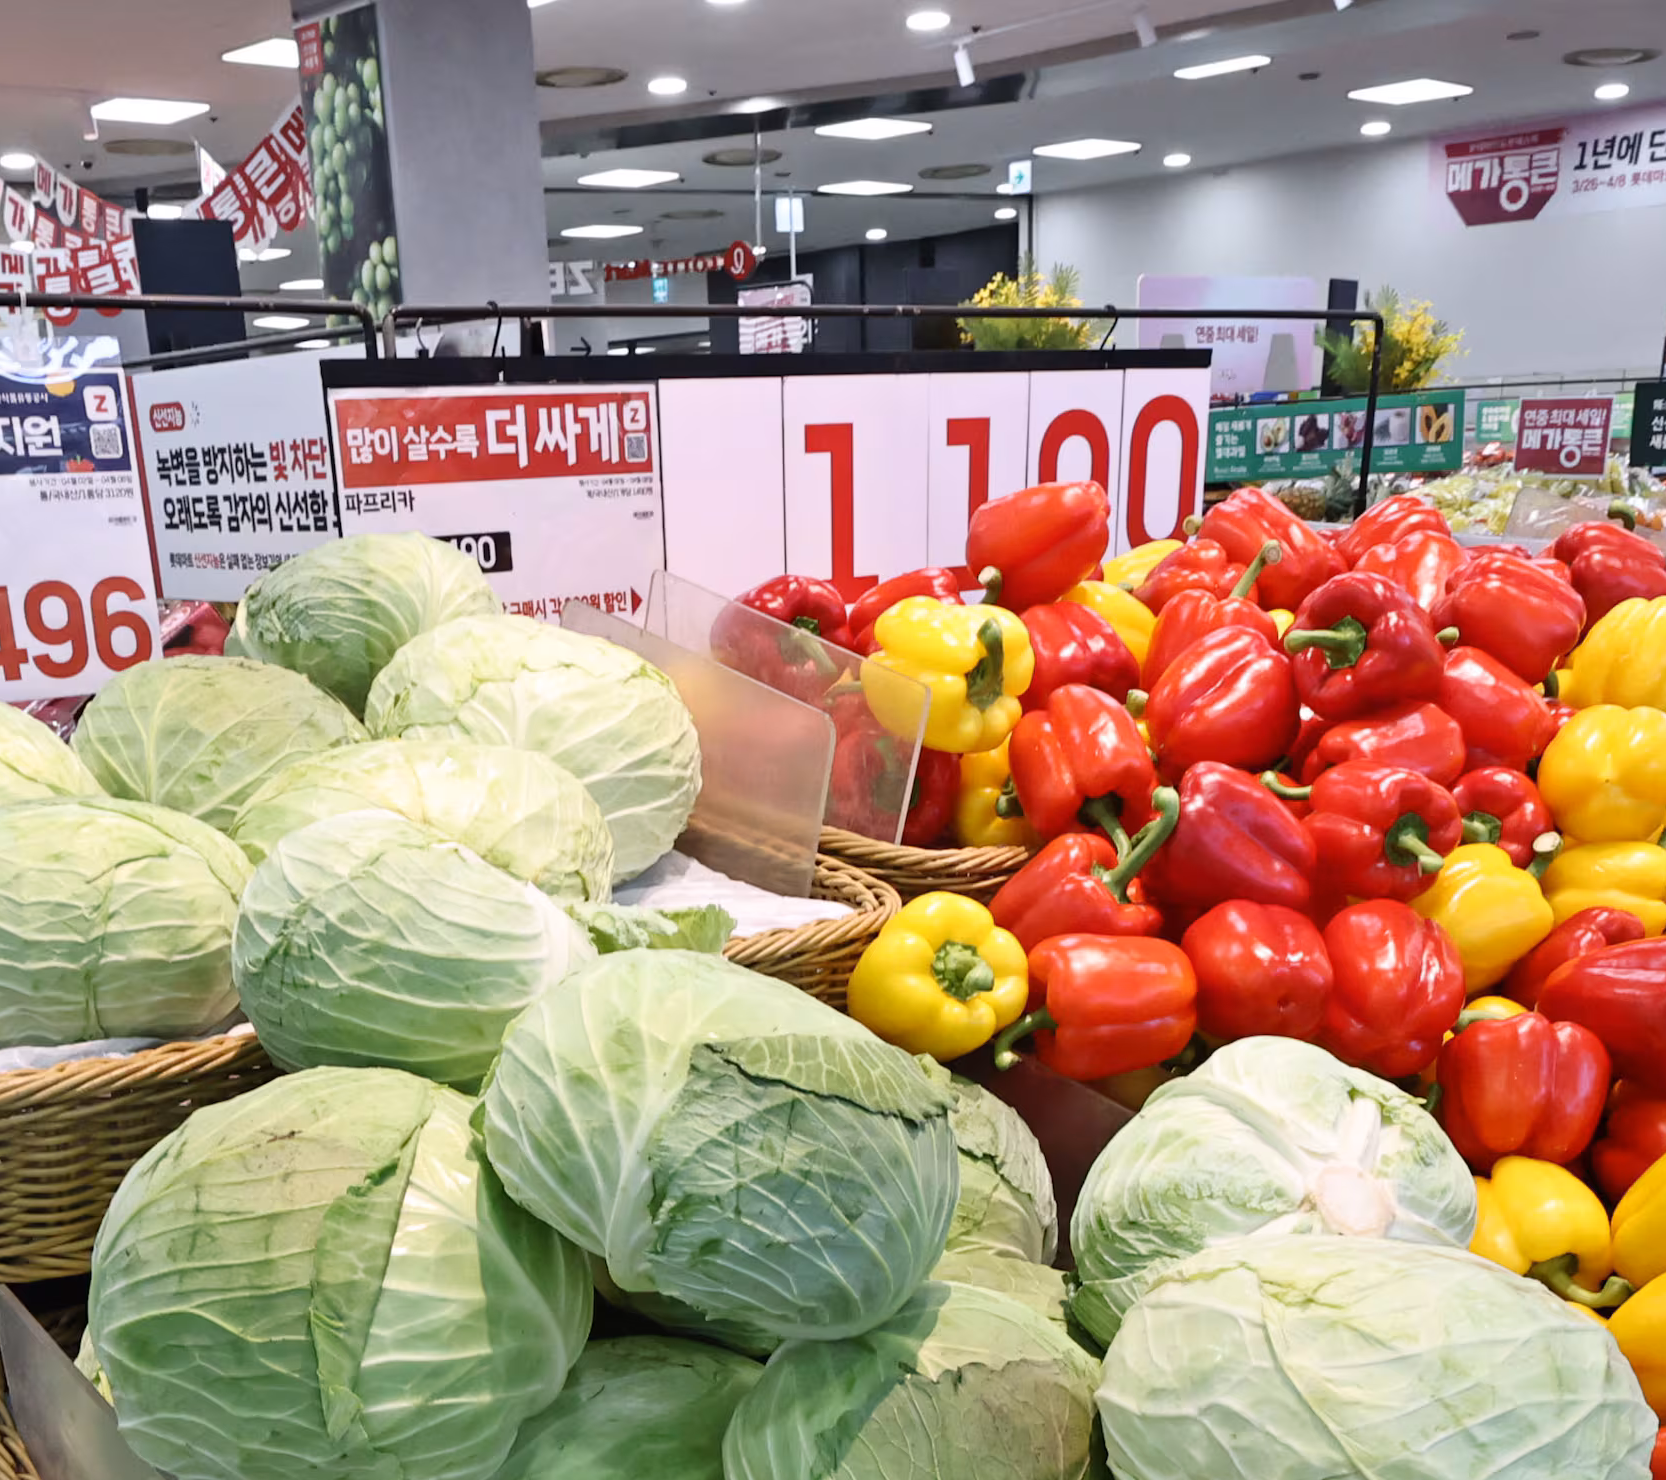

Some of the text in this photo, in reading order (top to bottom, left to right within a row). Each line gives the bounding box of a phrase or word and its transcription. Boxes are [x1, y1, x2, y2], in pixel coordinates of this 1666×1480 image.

[1573, 132, 1643, 171] 1년에
[1446, 147, 1560, 213] 메가통큰
[346, 402, 621, 470] 많이 살수록 더 싸게
[1523, 410, 1549, 427] 연중
[1549, 408, 1575, 426] 최대
[1576, 408, 1607, 427] 세일!
[156, 436, 328, 487] 녹변을 방지하는 빛 차단
[1521, 428, 1604, 468] 메가통큰
[163, 494, 222, 534] 오래도록
[222, 492, 273, 534] 감자의
[274, 490, 329, 533] 신선함
[344, 490, 416, 516] 파프리카
[449, 535, 497, 569] 90
[602, 591, 627, 614] 할인
